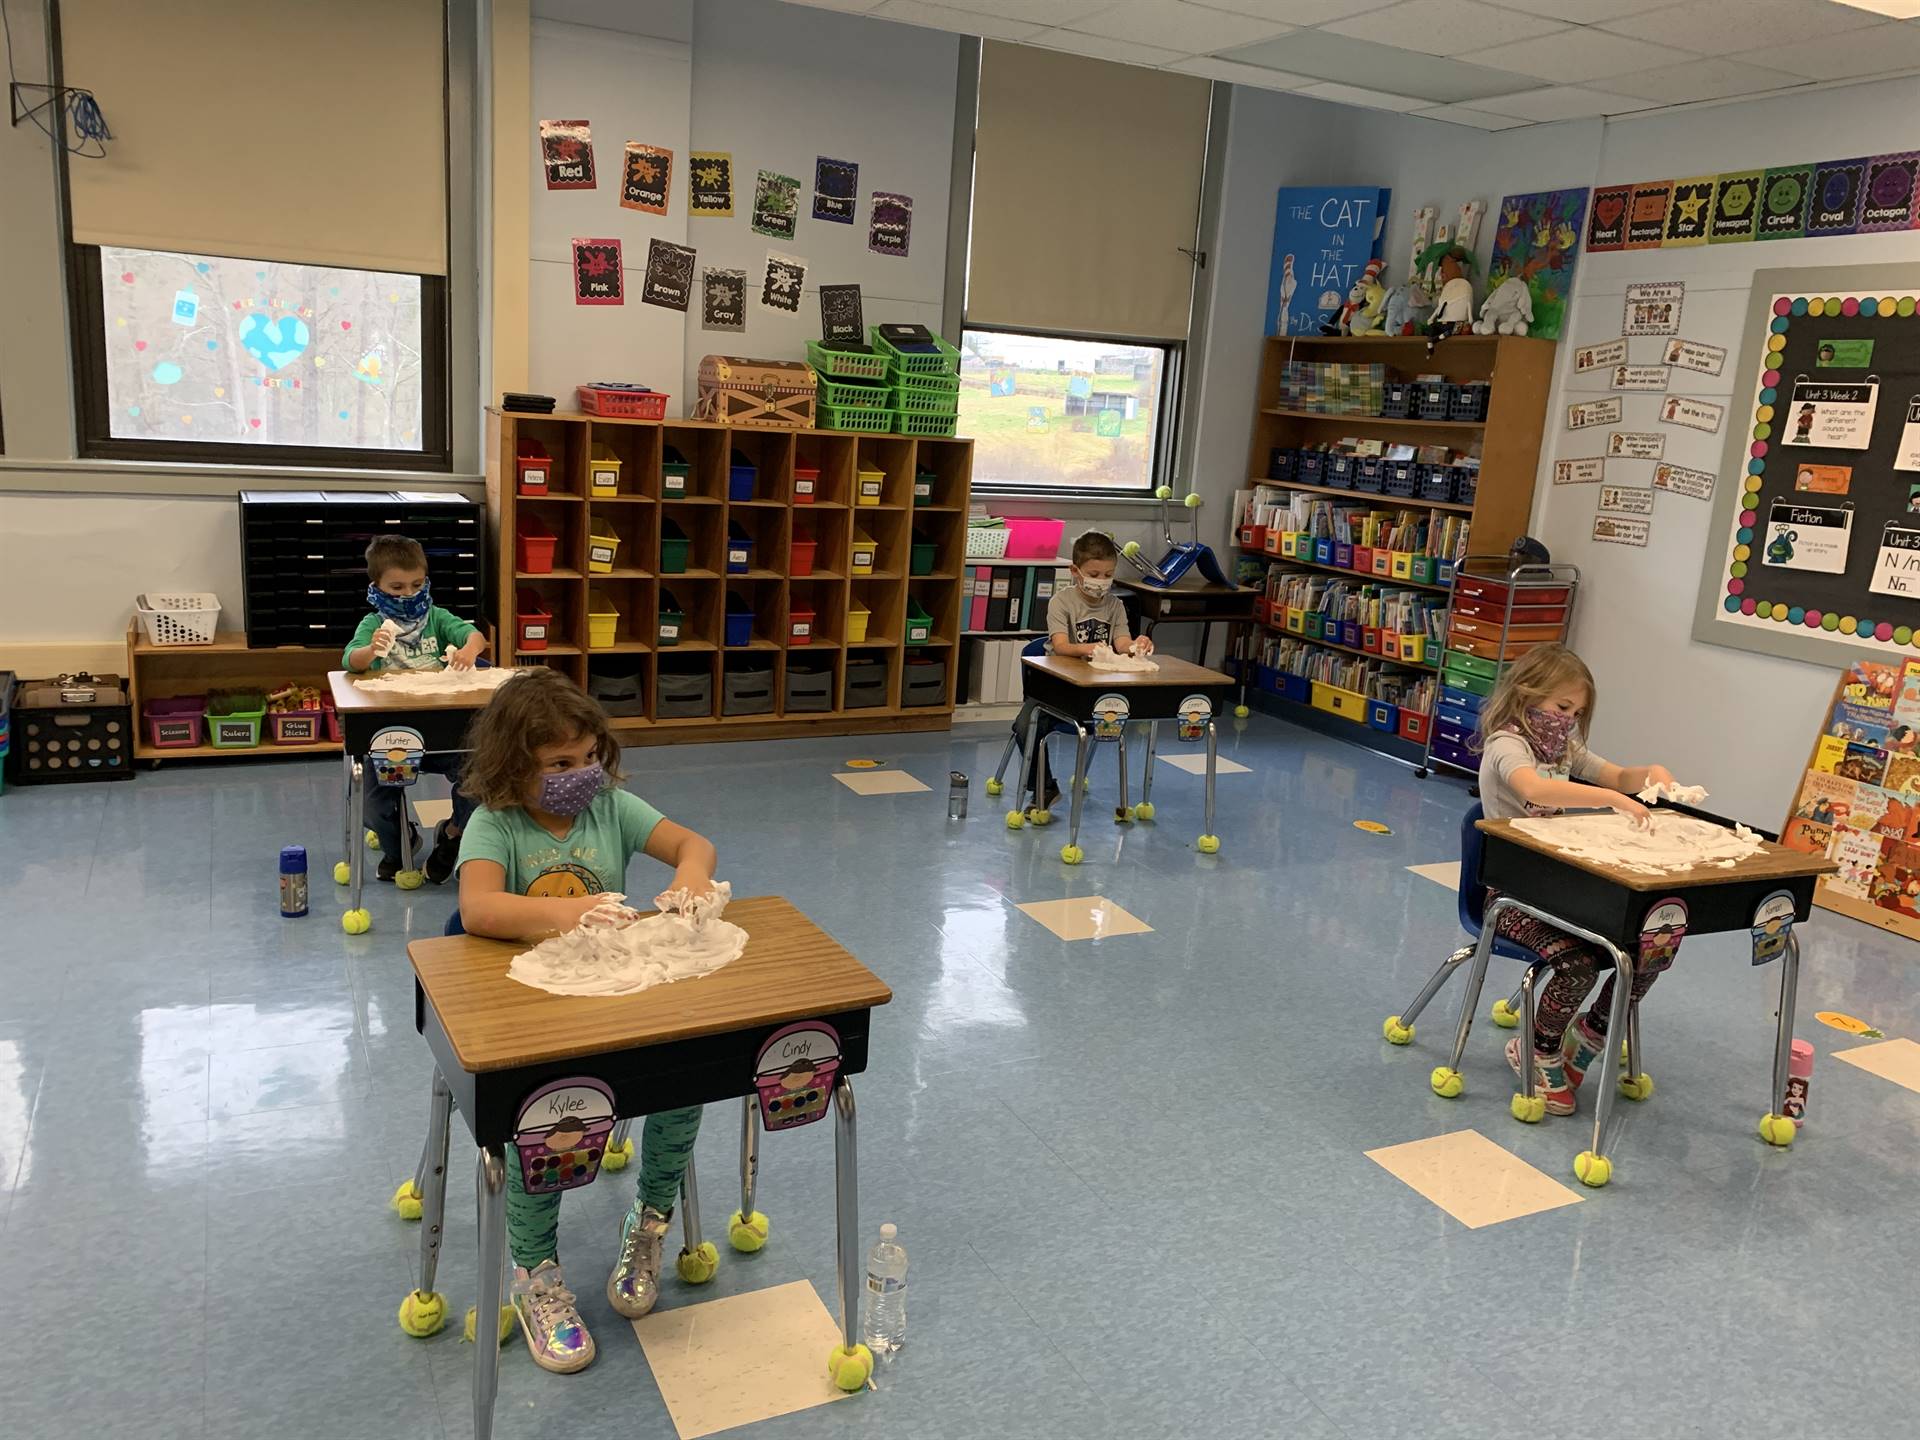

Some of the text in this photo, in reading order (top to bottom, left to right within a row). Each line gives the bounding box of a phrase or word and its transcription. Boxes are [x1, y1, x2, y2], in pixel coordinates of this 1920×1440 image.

[558, 165, 583, 178] Red
[628, 186, 663, 202] Orange
[698, 194, 725, 205] Yellow
[826, 199, 844, 211] Blue
[1288, 197, 1371, 228] THE CAT
[1820, 211, 1844, 222] Oval
[1866, 207, 1908, 219] Octagon
[762, 213, 787, 227] Green
[1715, 218, 1750, 230] Hexagon
[1767, 214, 1795, 226] Circle
[1595, 229, 1617, 239] Heart
[1631, 227, 1661, 237] Rectangle
[1677, 223, 1696, 233] Star
[877, 232, 902, 245] Purple
[1332, 234, 1345, 246] IN
[1321, 249, 1345, 261] THE
[1310, 262, 1360, 288] HAT
[590, 282, 609, 292] Pink
[653, 283, 681, 297] Brown
[770, 292, 792, 305] White
[713, 309, 736, 321] Gray
[832, 324, 854, 334] Black
[1805, 389, 1859, 400] Unit 3 Week 2
[1790, 508, 1823, 525] Fiction
[1890, 533, 1911, 547] Unit
[1884, 552, 1899, 569] N
[286, 722, 308, 730] Glue
[222, 729, 250, 737] Rulers
[284, 729, 309, 737] Sticks
[385, 734, 411, 745] Hunter
[782, 1040, 812, 1059] Cindy
[549, 1095, 588, 1116] Kylee
